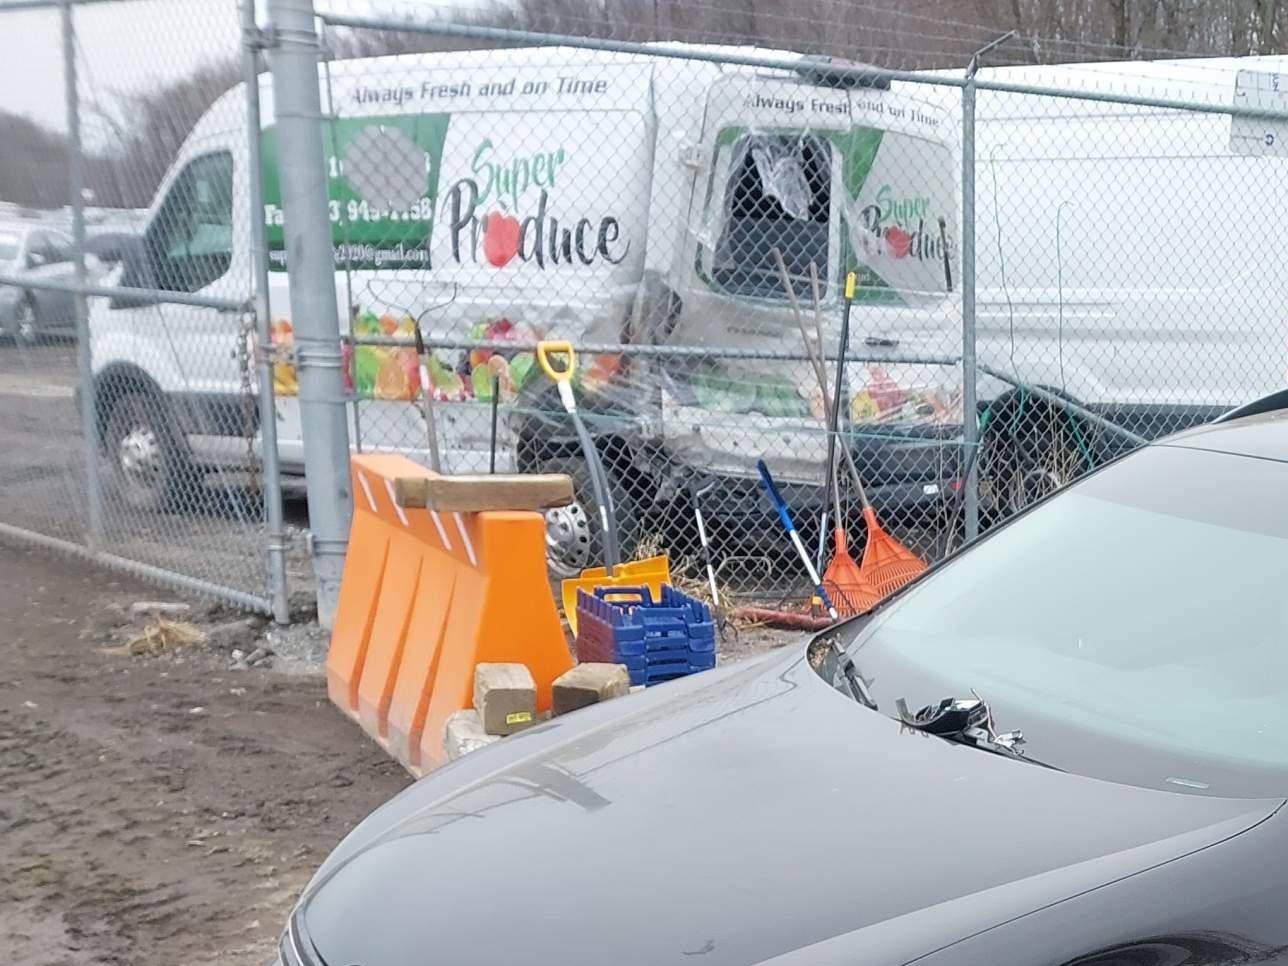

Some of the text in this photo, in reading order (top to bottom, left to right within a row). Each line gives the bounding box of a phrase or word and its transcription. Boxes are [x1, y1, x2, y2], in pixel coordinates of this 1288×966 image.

[353, 76, 608, 105] Always Fresh and on Time
[471, 137, 566, 214] Super
[876, 184, 930, 228] Super
